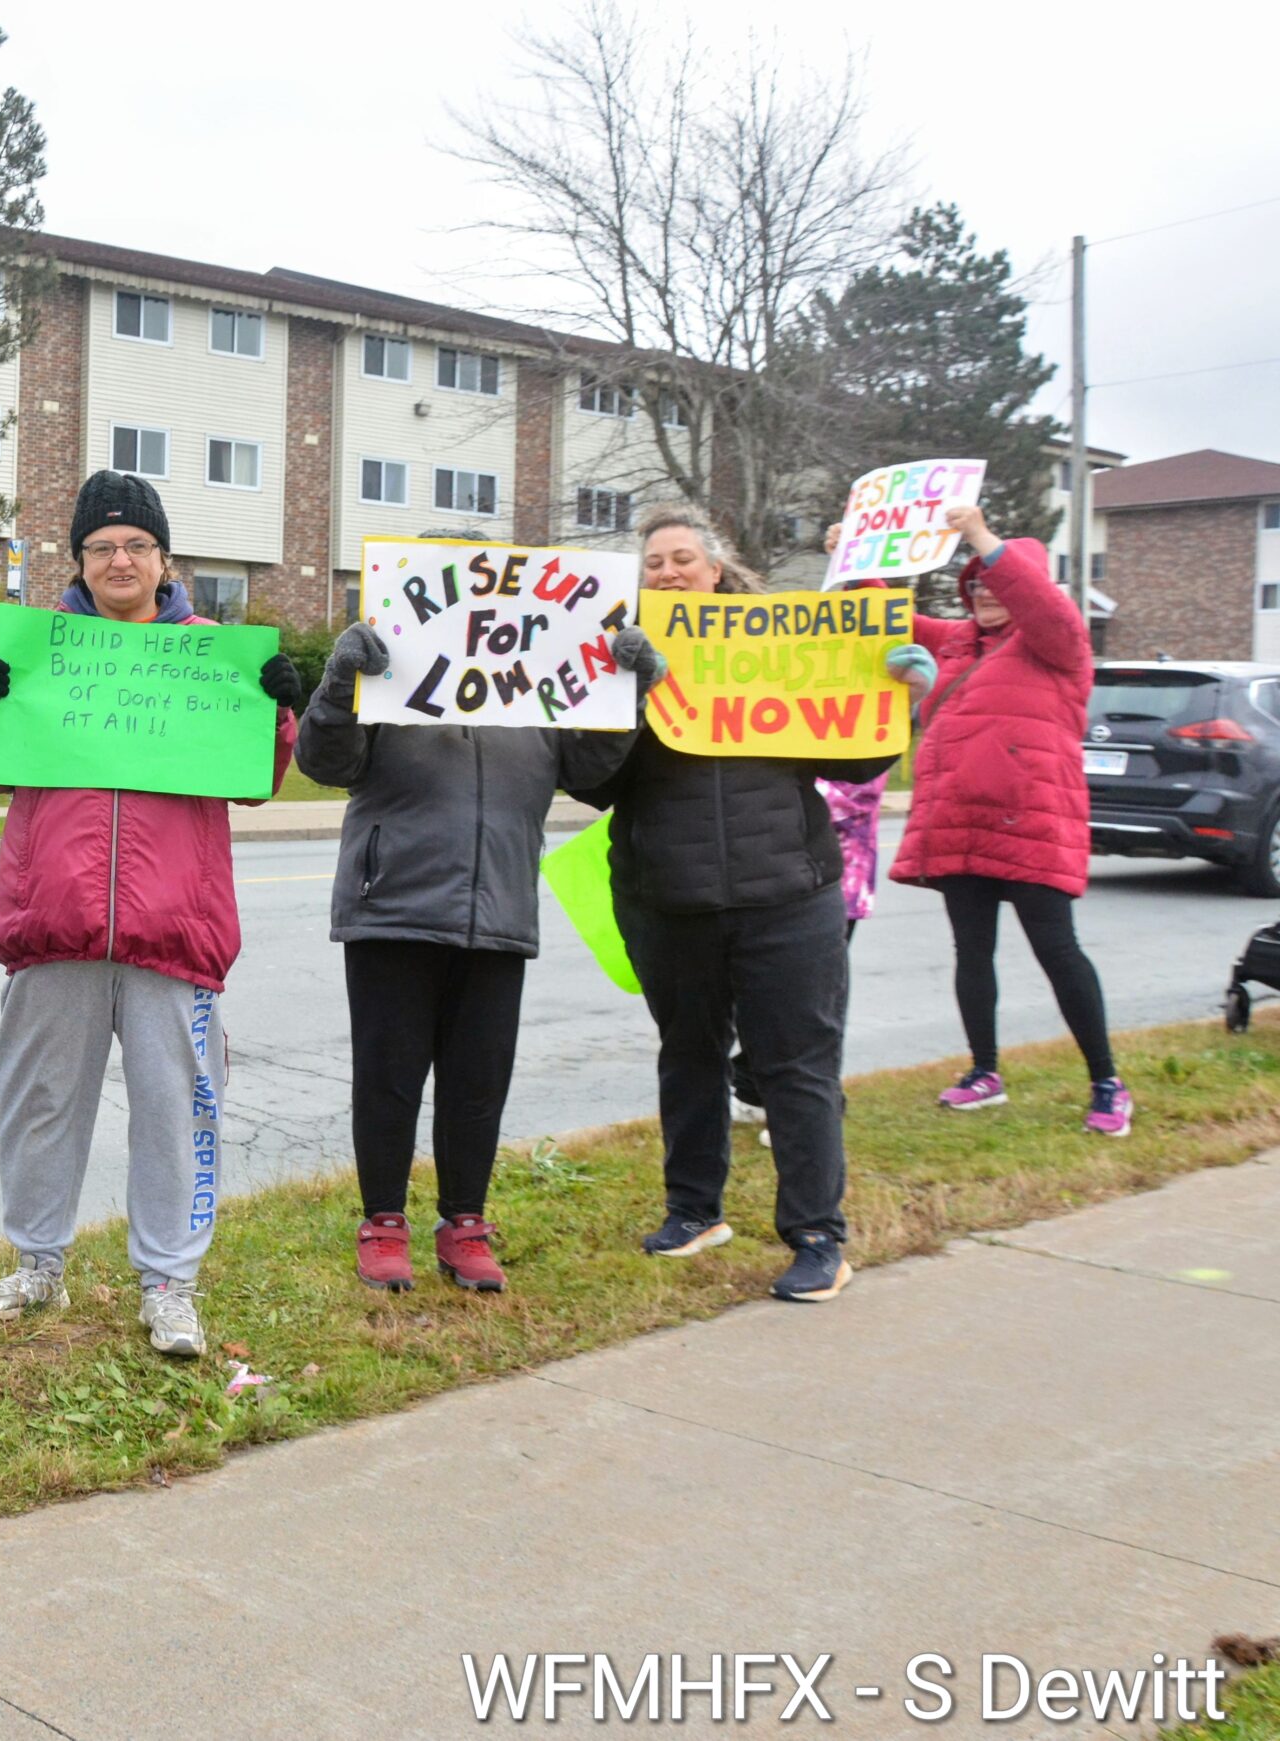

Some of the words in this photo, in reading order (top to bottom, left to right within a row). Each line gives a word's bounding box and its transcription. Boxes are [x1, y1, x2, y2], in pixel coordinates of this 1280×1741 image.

[845, 466, 980, 517] ESPECT
[855, 500, 942, 537] DON'T
[839, 528, 961, 573] EJECT
[402, 551, 529, 625] RISE
[532, 556, 600, 612] UP
[665, 597, 908, 639] AFFORDABLE
[144, 633, 215, 656] HERE
[405, 653, 535, 718] LOW
[537, 599, 629, 723] RENT
[62, 711, 95, 728] AT
[193, 1074, 217, 1120] ME
[190, 1129, 216, 1232] SPACE
